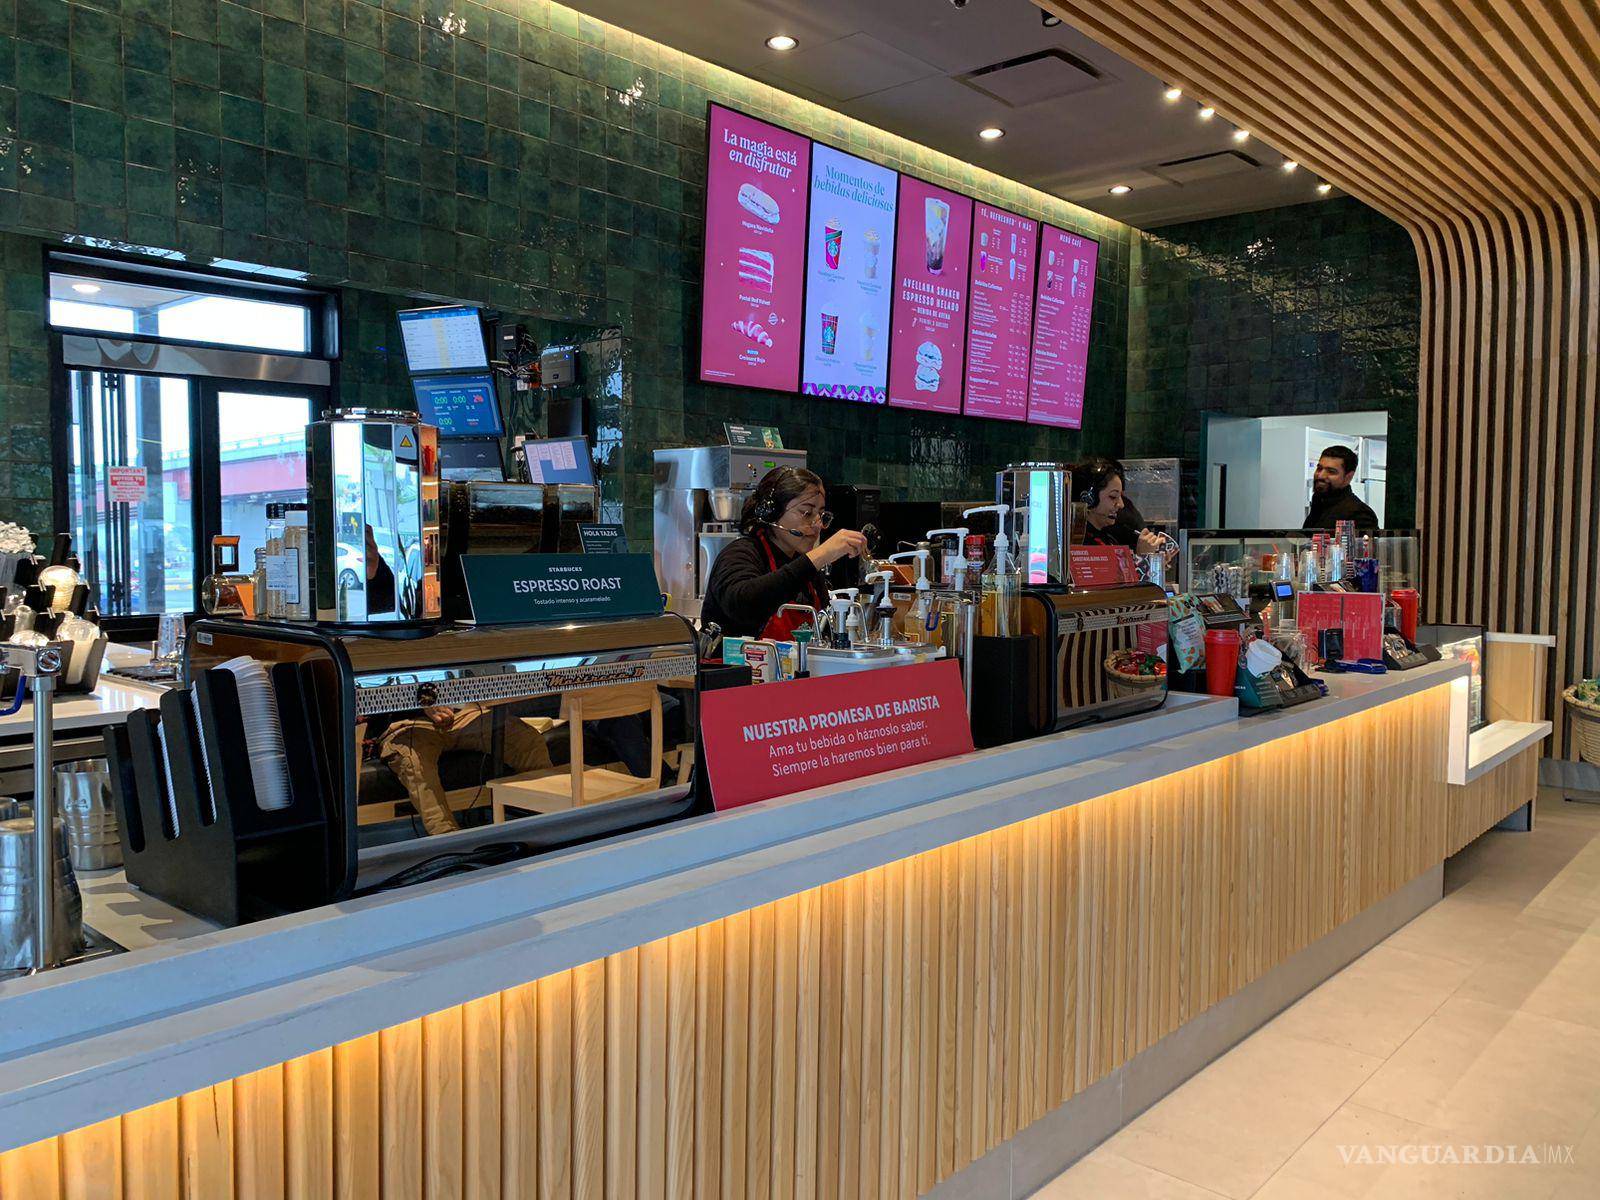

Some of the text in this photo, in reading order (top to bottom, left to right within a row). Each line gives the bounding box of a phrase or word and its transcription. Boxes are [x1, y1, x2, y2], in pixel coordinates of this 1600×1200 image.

[724, 129, 797, 166] La magia está
[729, 149, 792, 179] en disfrutar
[814, 175, 894, 212] bebidas deliciosas
[826, 165, 885, 196] Momentos de
[902, 277, 961, 300] AVELLANA SHAKEN
[902, 290, 960, 312] ESPRESSO HELADO
[513, 577, 622, 593] ESPRESSO ROAST
[579, 595, 611, 603] acaramelado
[742, 695, 940, 742] NUESTRA PROMESA DE BARISTA
[769, 719, 928, 759] Ama tu bebida o háznoslo saber.
[772, 735, 931, 777] Siempre la haremos bien para ti.
